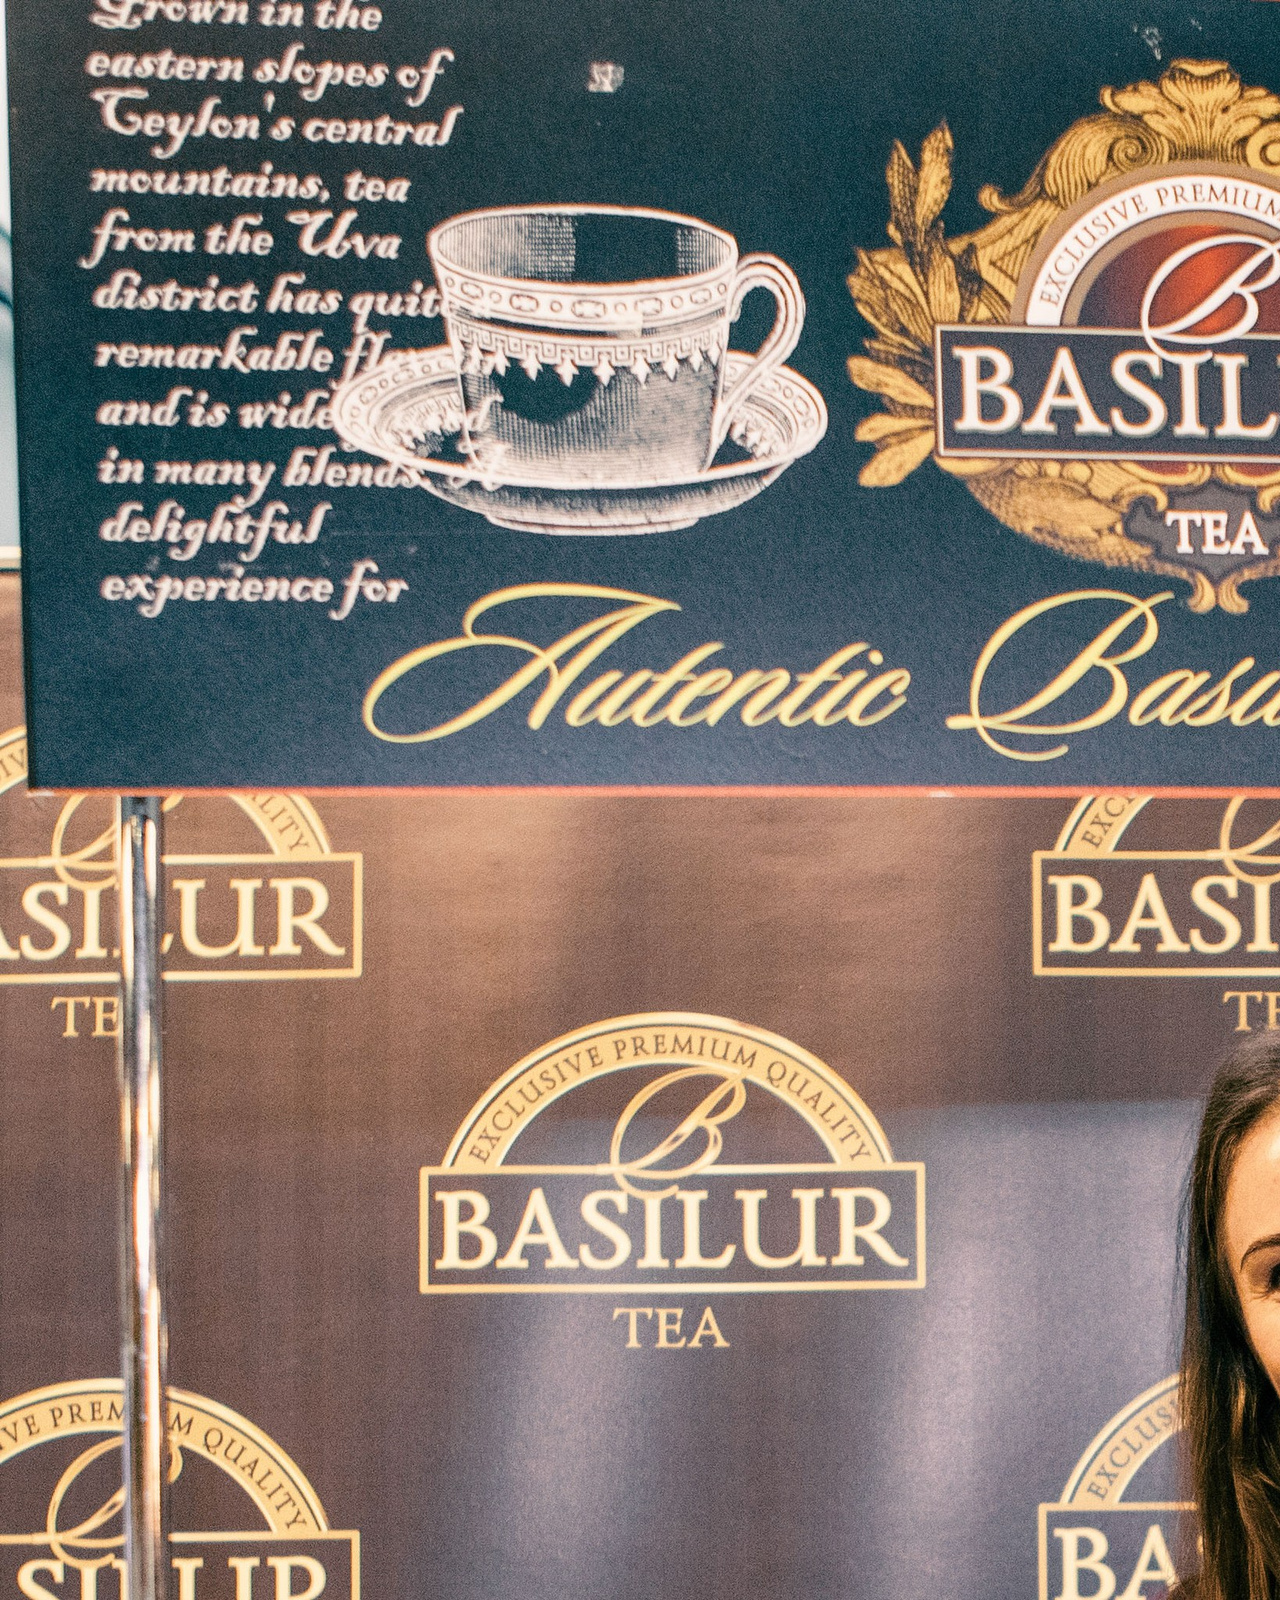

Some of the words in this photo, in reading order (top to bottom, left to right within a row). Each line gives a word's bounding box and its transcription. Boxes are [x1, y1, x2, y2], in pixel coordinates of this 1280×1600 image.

[259, 0, 303, 27] in
[314, 0, 383, 31] the
[85, 47, 245, 82] eastern
[254, 41, 389, 102] slopes
[396, 47, 455, 107] of
[90, 86, 296, 159] Ceylon's
[302, 104, 465, 146] central
[90, 161, 330, 203] mountains,
[344, 171, 411, 202] tea
[78, 207, 196, 270] from
[204, 212, 274, 256] the
[286, 208, 402, 260] Uva
[1039, 192, 1150, 309] EXCLUSIVE
[93, 268, 259, 313] district
[265, 272, 342, 315] has
[349, 279, 449, 335] quit
[95, 325, 333, 374] remarkable
[97, 386, 193, 427] and
[189, 391, 230, 427] is
[239, 391, 345, 433] wide
[98, 446, 144, 486] in
[154, 459, 276, 508] many
[99, 499, 333, 562] delightful
[1165, 509, 1269, 556] TEA
[100, 566, 334, 619] experience
[329, 559, 409, 620] for
[363, 583, 911, 743] Autentic
[51, 995, 121, 1038] TE
[469, 1045, 604, 1164] EXCLUSIVE
[613, 1032, 758, 1068] PREMIUM
[766, 1060, 872, 1162] QUALITY
[434, 1188, 909, 1271] BASILUR
[613, 1306, 730, 1348] TEA
[49, 1401, 195, 1436] PREMM
[202, 1426, 308, 1530] QUALITY
[1087, 1400, 1180, 1500] EXCLUS
